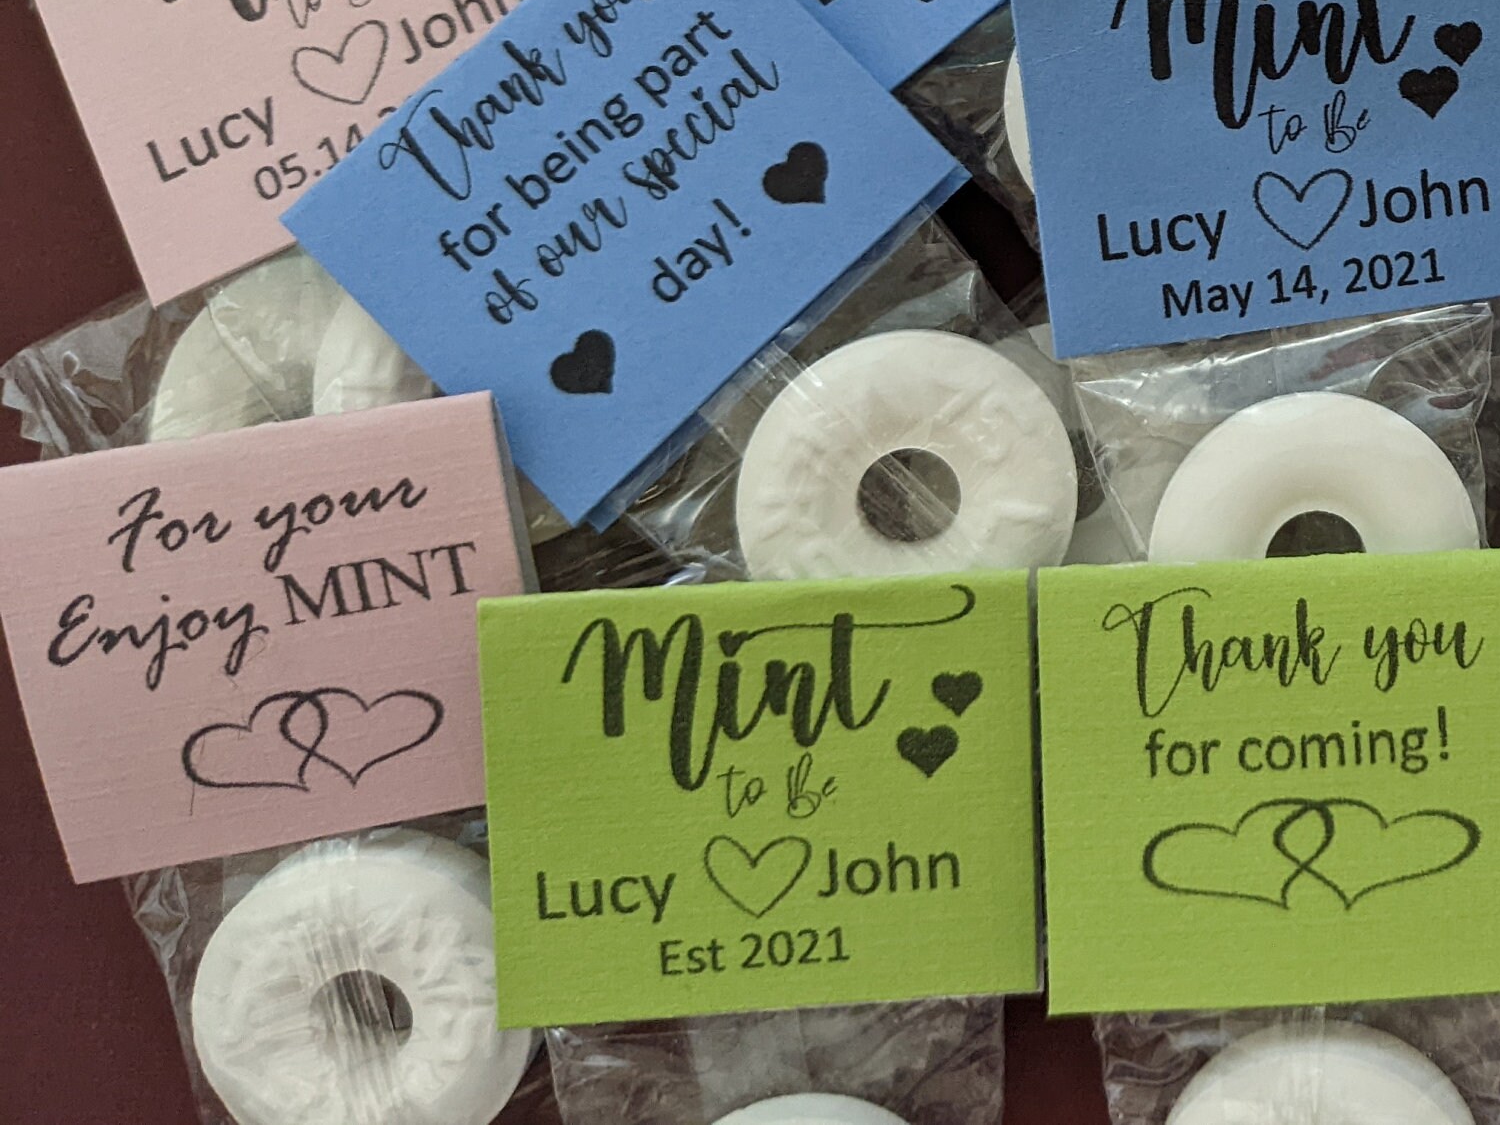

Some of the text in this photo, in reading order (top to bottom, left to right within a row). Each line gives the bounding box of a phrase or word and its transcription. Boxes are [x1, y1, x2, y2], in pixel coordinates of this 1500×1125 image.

[146, 96, 274, 182] Lucy
[377, 40, 567, 201] Thank
[438, 11, 732, 272] for being part
[1258, 104, 1307, 155] to
[485, 45, 779, 325] of our special
[1097, 169, 1490, 261] Lucy John
[652, 198, 751, 303] day!
[1162, 248, 1445, 318] May 14, 2021
[107, 478, 427, 573] For your
[47, 541, 476, 691] Enjoy MINT
[1102, 587, 1484, 719] Thank you
[561, 584, 976, 792] Mint
[1144, 706, 1449, 778] for coming!
[716, 765, 767, 819] to
[536, 841, 960, 924] Lucy John
[659, 926, 850, 976] Est 2021
